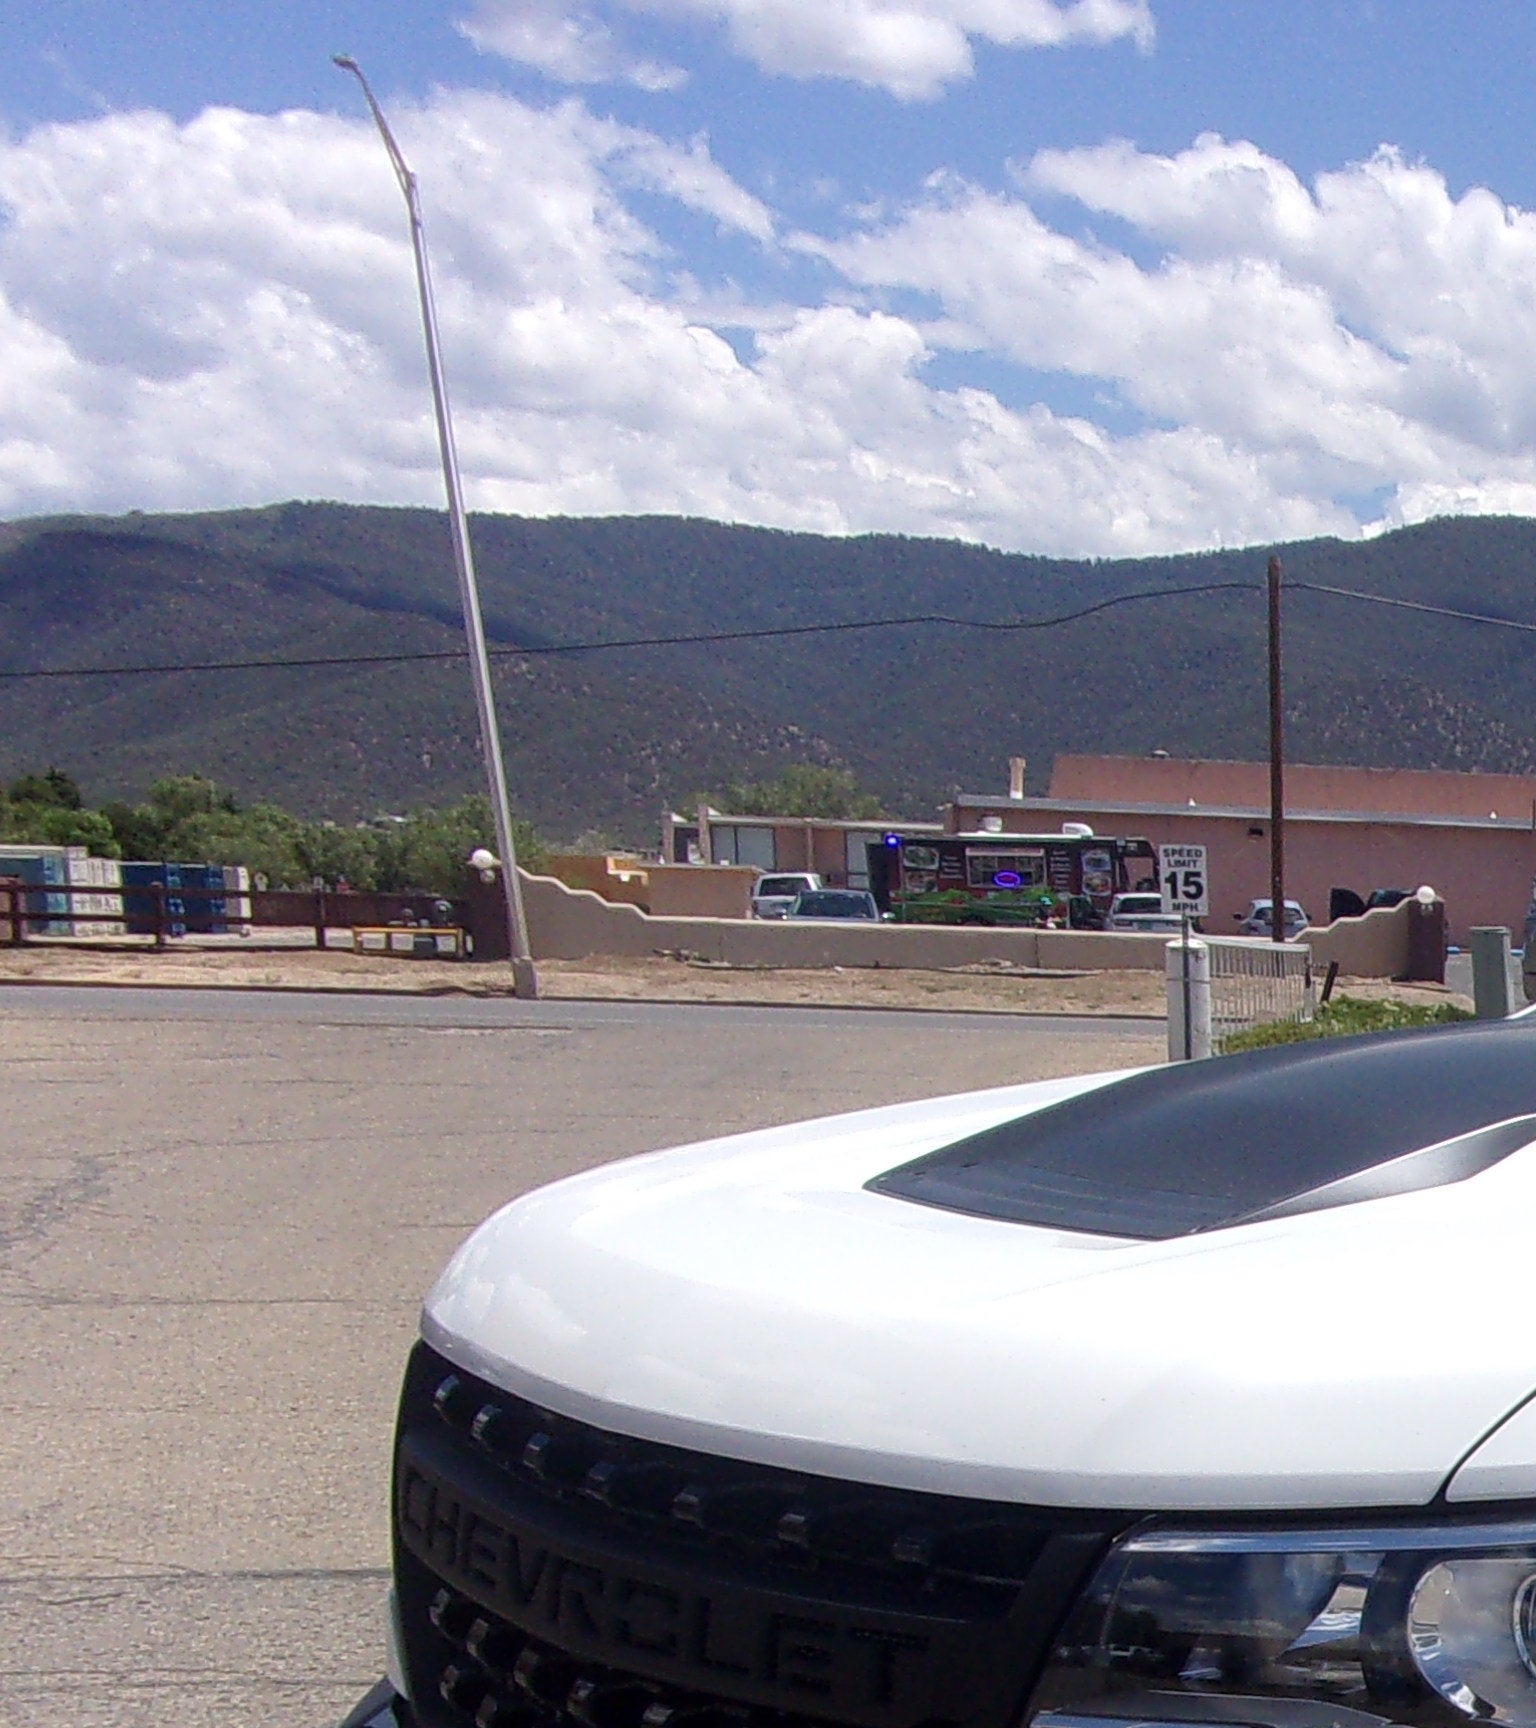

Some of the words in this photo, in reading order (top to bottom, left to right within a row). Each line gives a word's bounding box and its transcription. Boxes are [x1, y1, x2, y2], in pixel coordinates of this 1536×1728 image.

[1163, 847, 1203, 858] SPEED
[1167, 859, 1198, 868] LIMIT
[1164, 871, 1204, 900] 15
[1172, 902, 1199, 912] MPH
[400, 1466, 930, 1704] CHEVROLET
